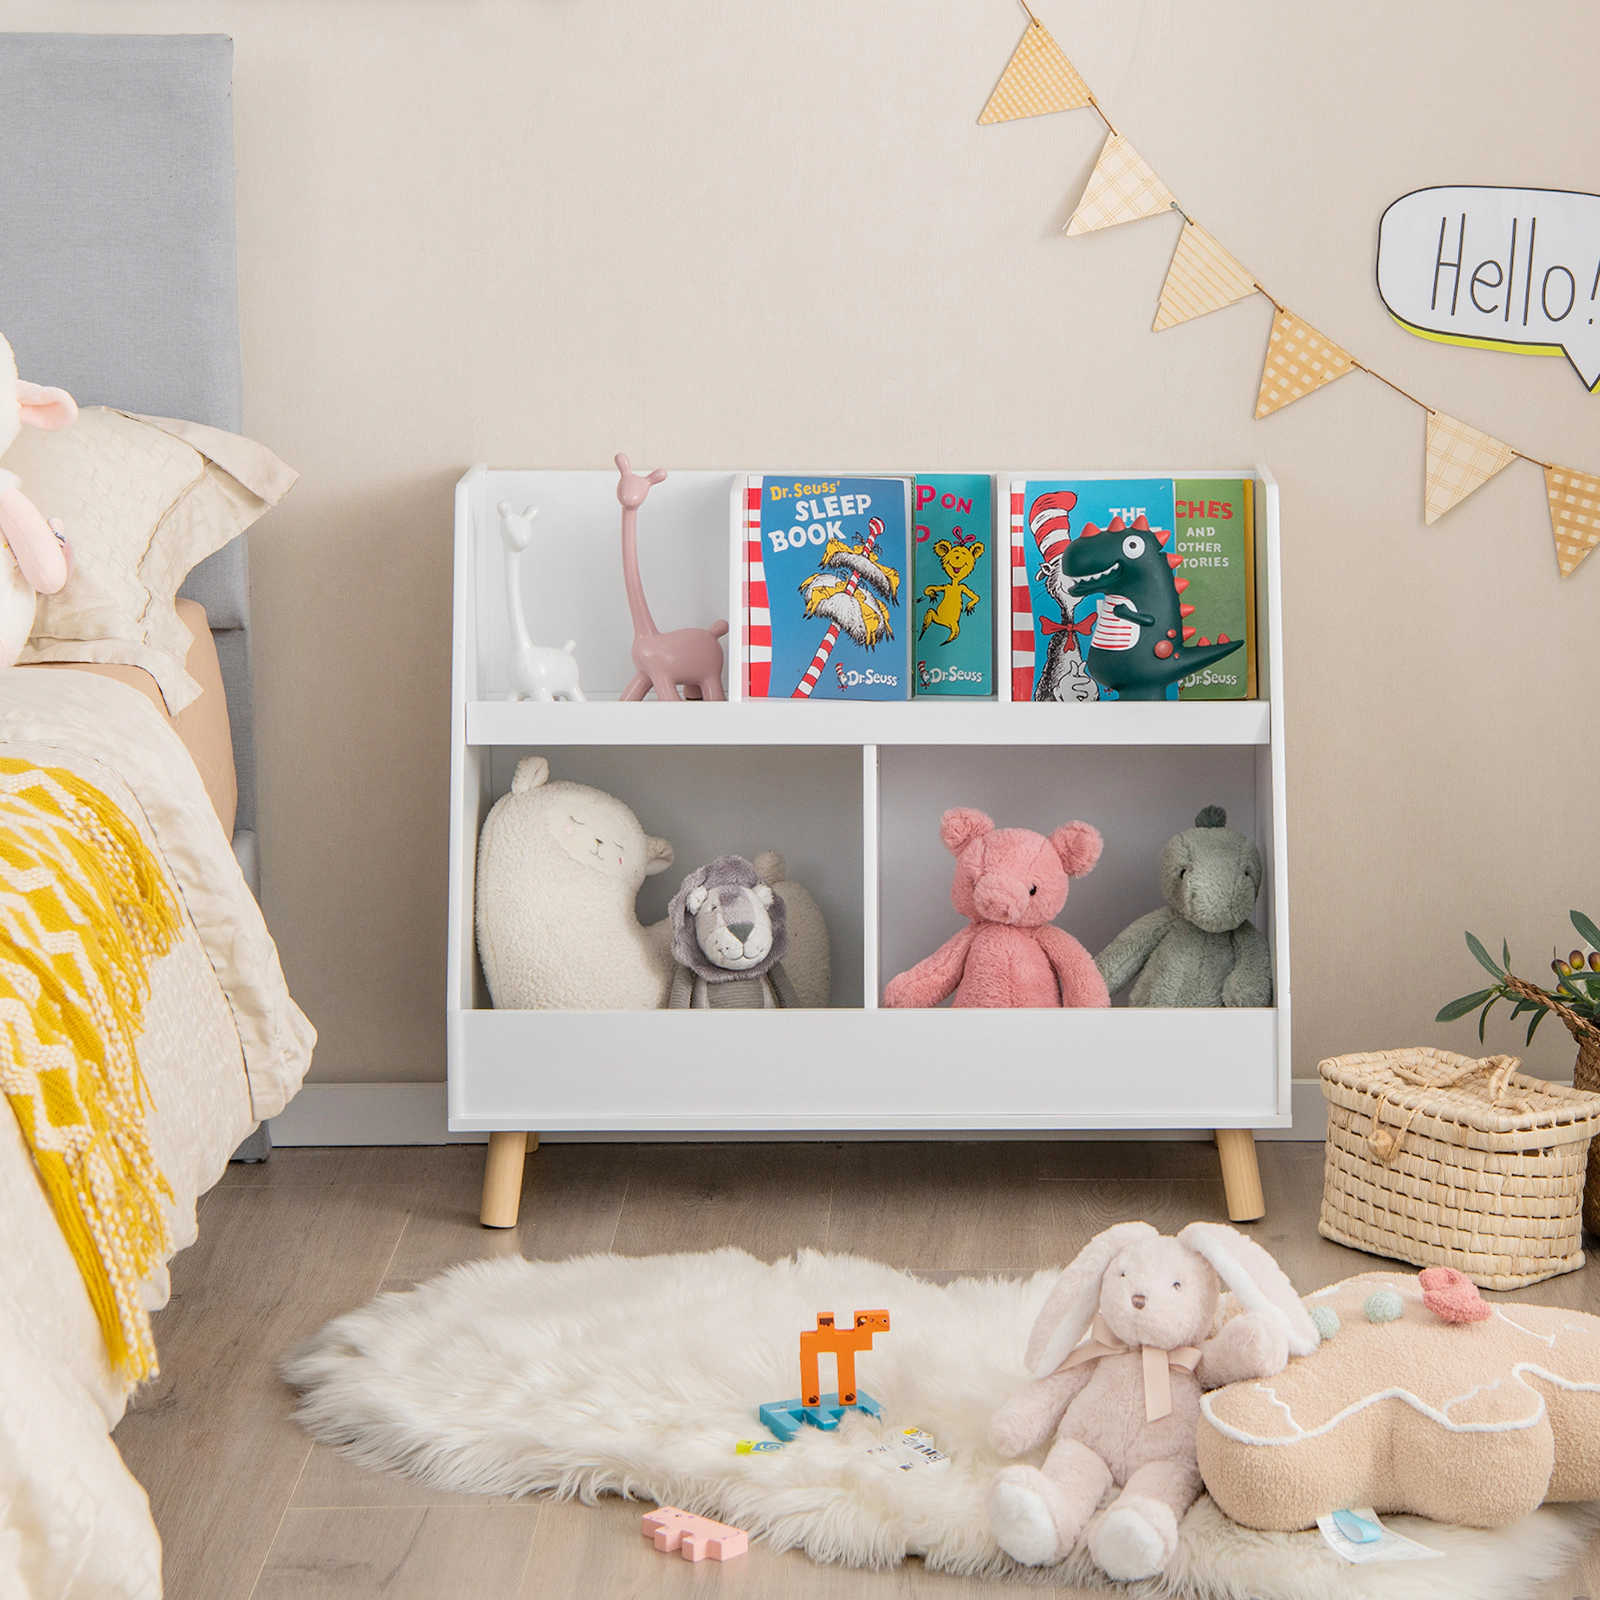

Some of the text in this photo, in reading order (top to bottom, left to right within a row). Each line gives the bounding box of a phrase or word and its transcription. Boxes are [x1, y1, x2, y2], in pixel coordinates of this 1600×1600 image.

[1431, 213, 1600, 326] Hello!
[795, 494, 872, 522] SLEEP
[941, 493, 973, 515] ON
[768, 521, 847, 553] BOOK
[1186, 527, 1216, 538] AND
[1177, 542, 1222, 553] OTHER
[1177, 557, 1229, 569] TORIES
